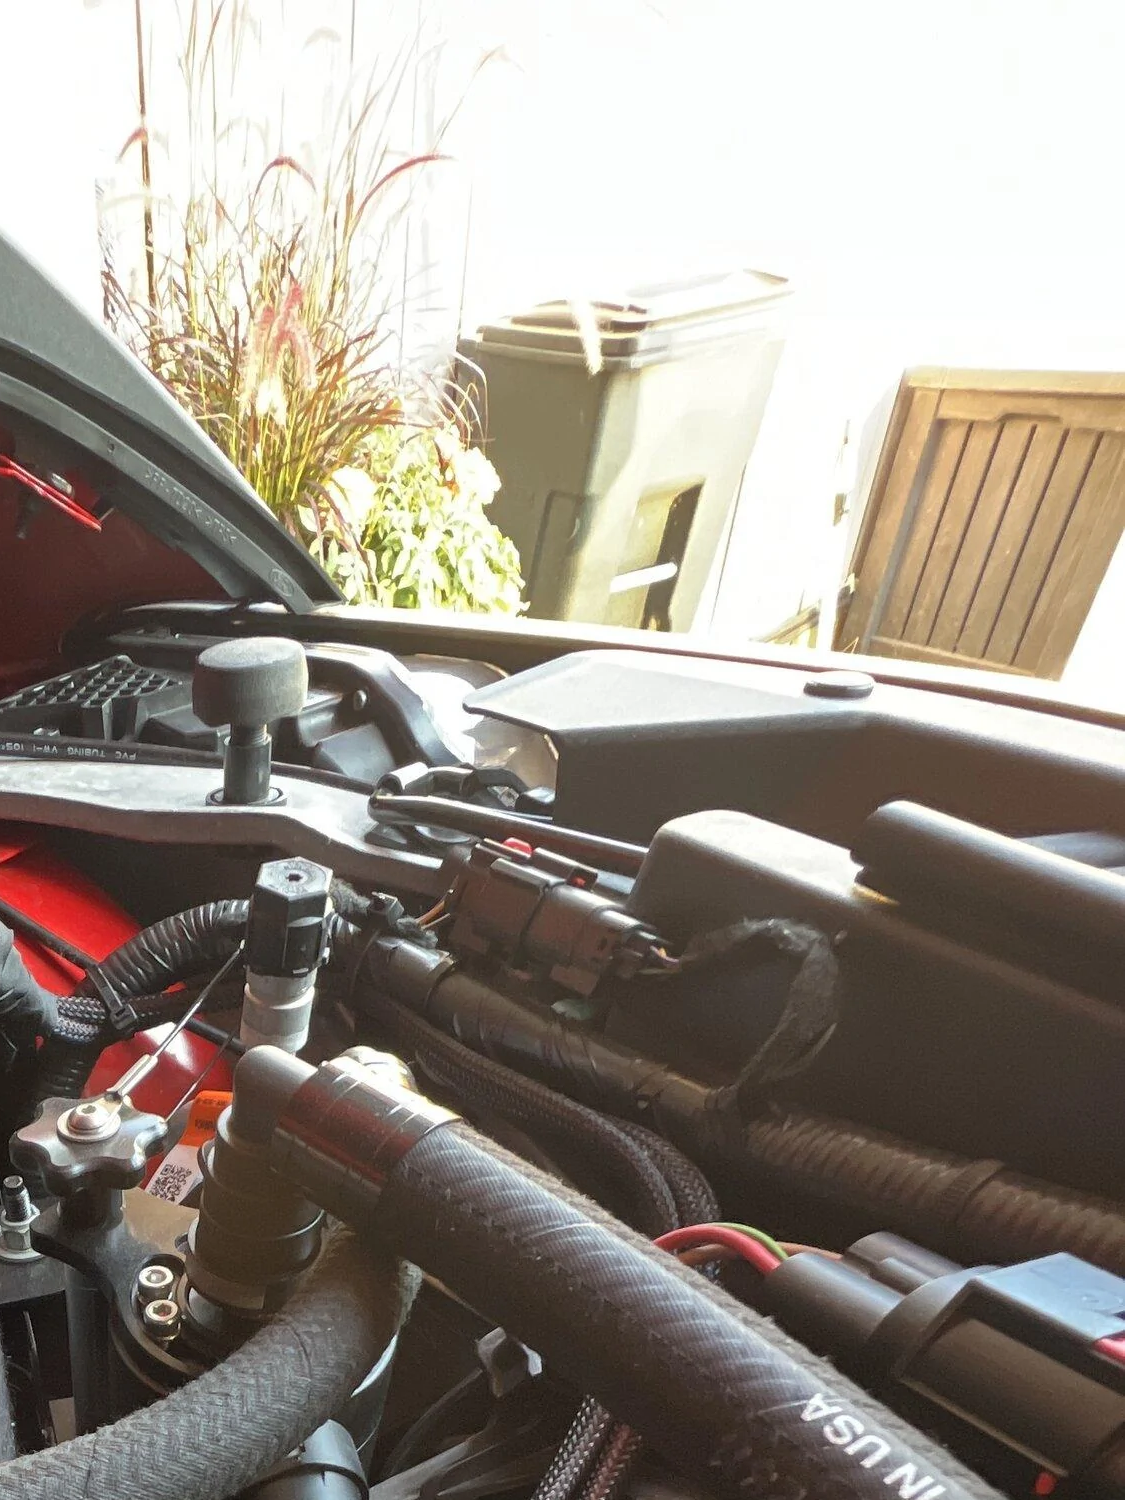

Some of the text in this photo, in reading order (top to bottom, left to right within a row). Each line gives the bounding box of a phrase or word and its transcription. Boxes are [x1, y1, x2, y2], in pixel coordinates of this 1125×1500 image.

[66, 746, 107, 759] TUBING
[114, 750, 137, 761] PVC
[799, 1391, 892, 1470] USA
